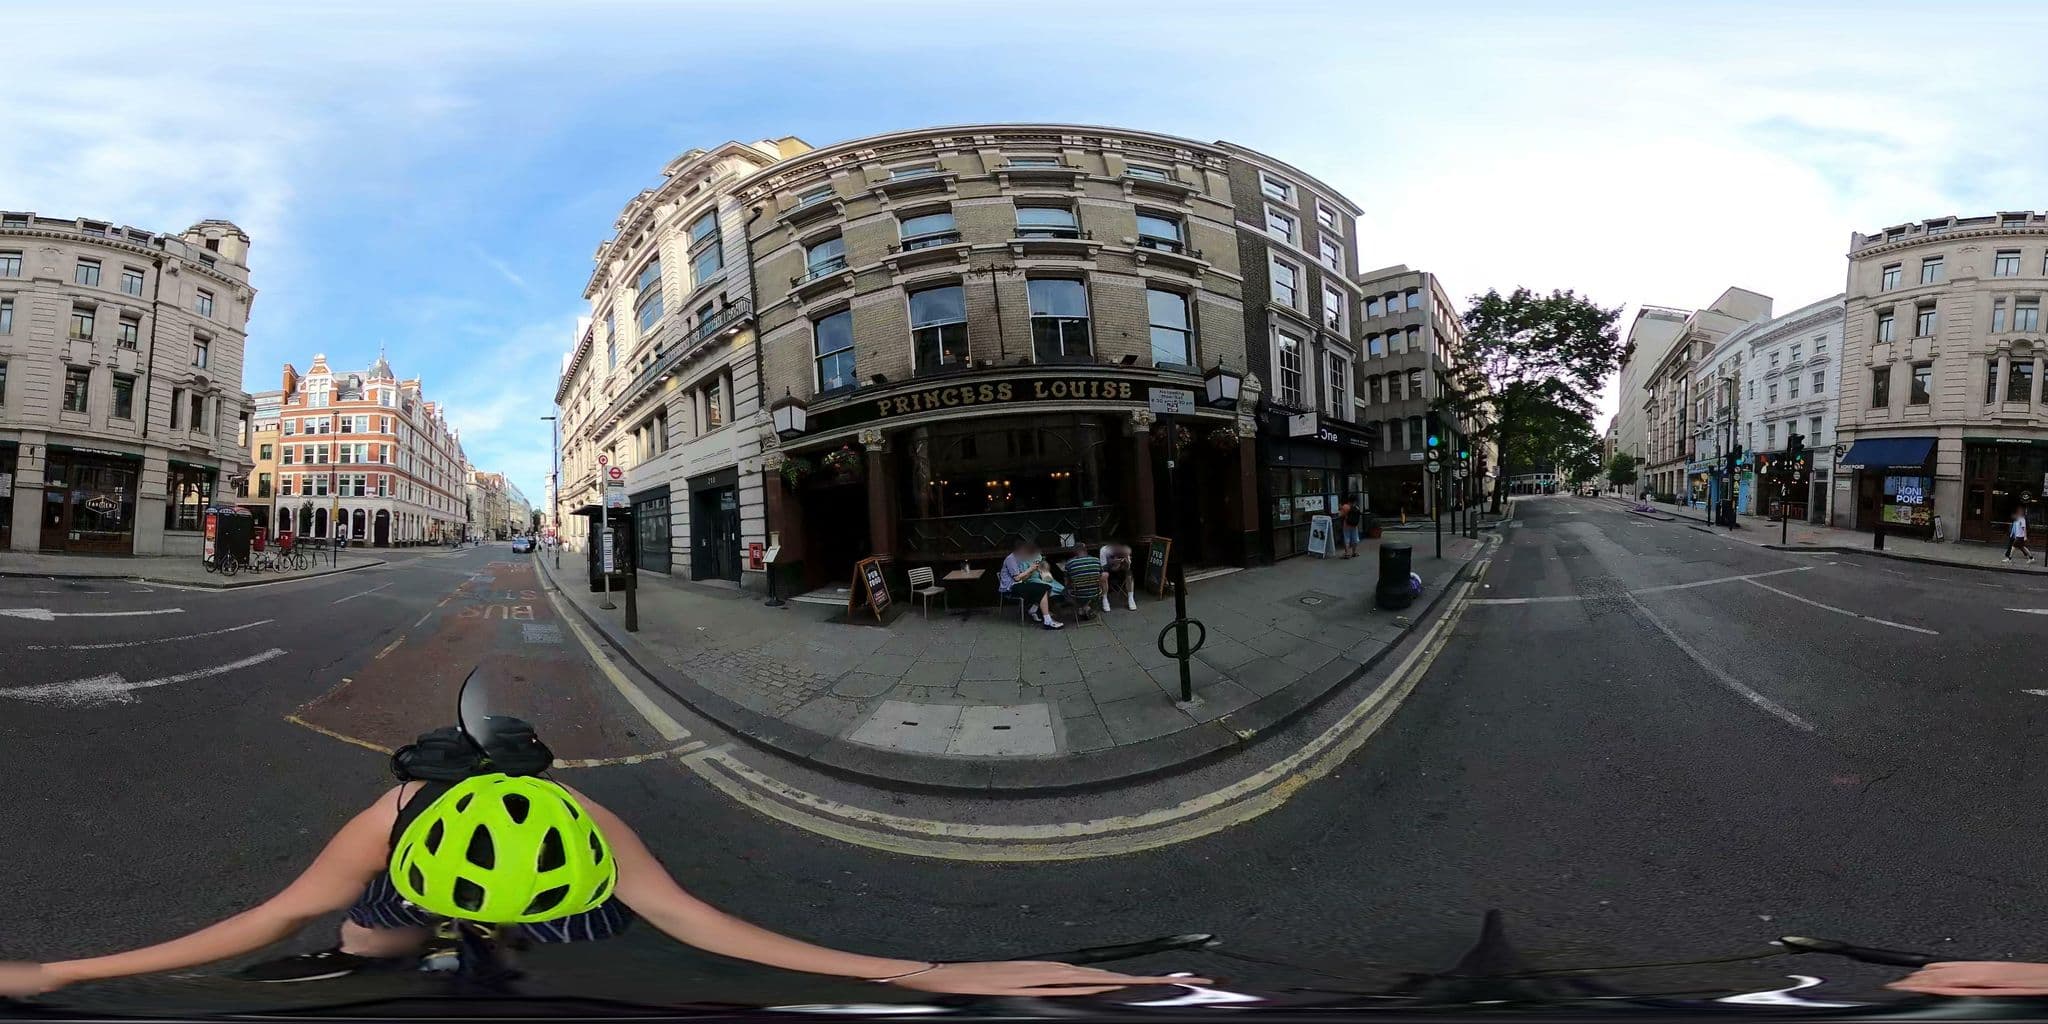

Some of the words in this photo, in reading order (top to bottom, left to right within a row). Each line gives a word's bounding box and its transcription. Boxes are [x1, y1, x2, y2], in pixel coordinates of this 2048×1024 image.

[877, 382, 1012, 417] PRINCESS
[1034, 380, 1132, 399] LOUISE
[1898, 487, 1922, 495] HONI
[1896, 494, 1923, 505] POKE
